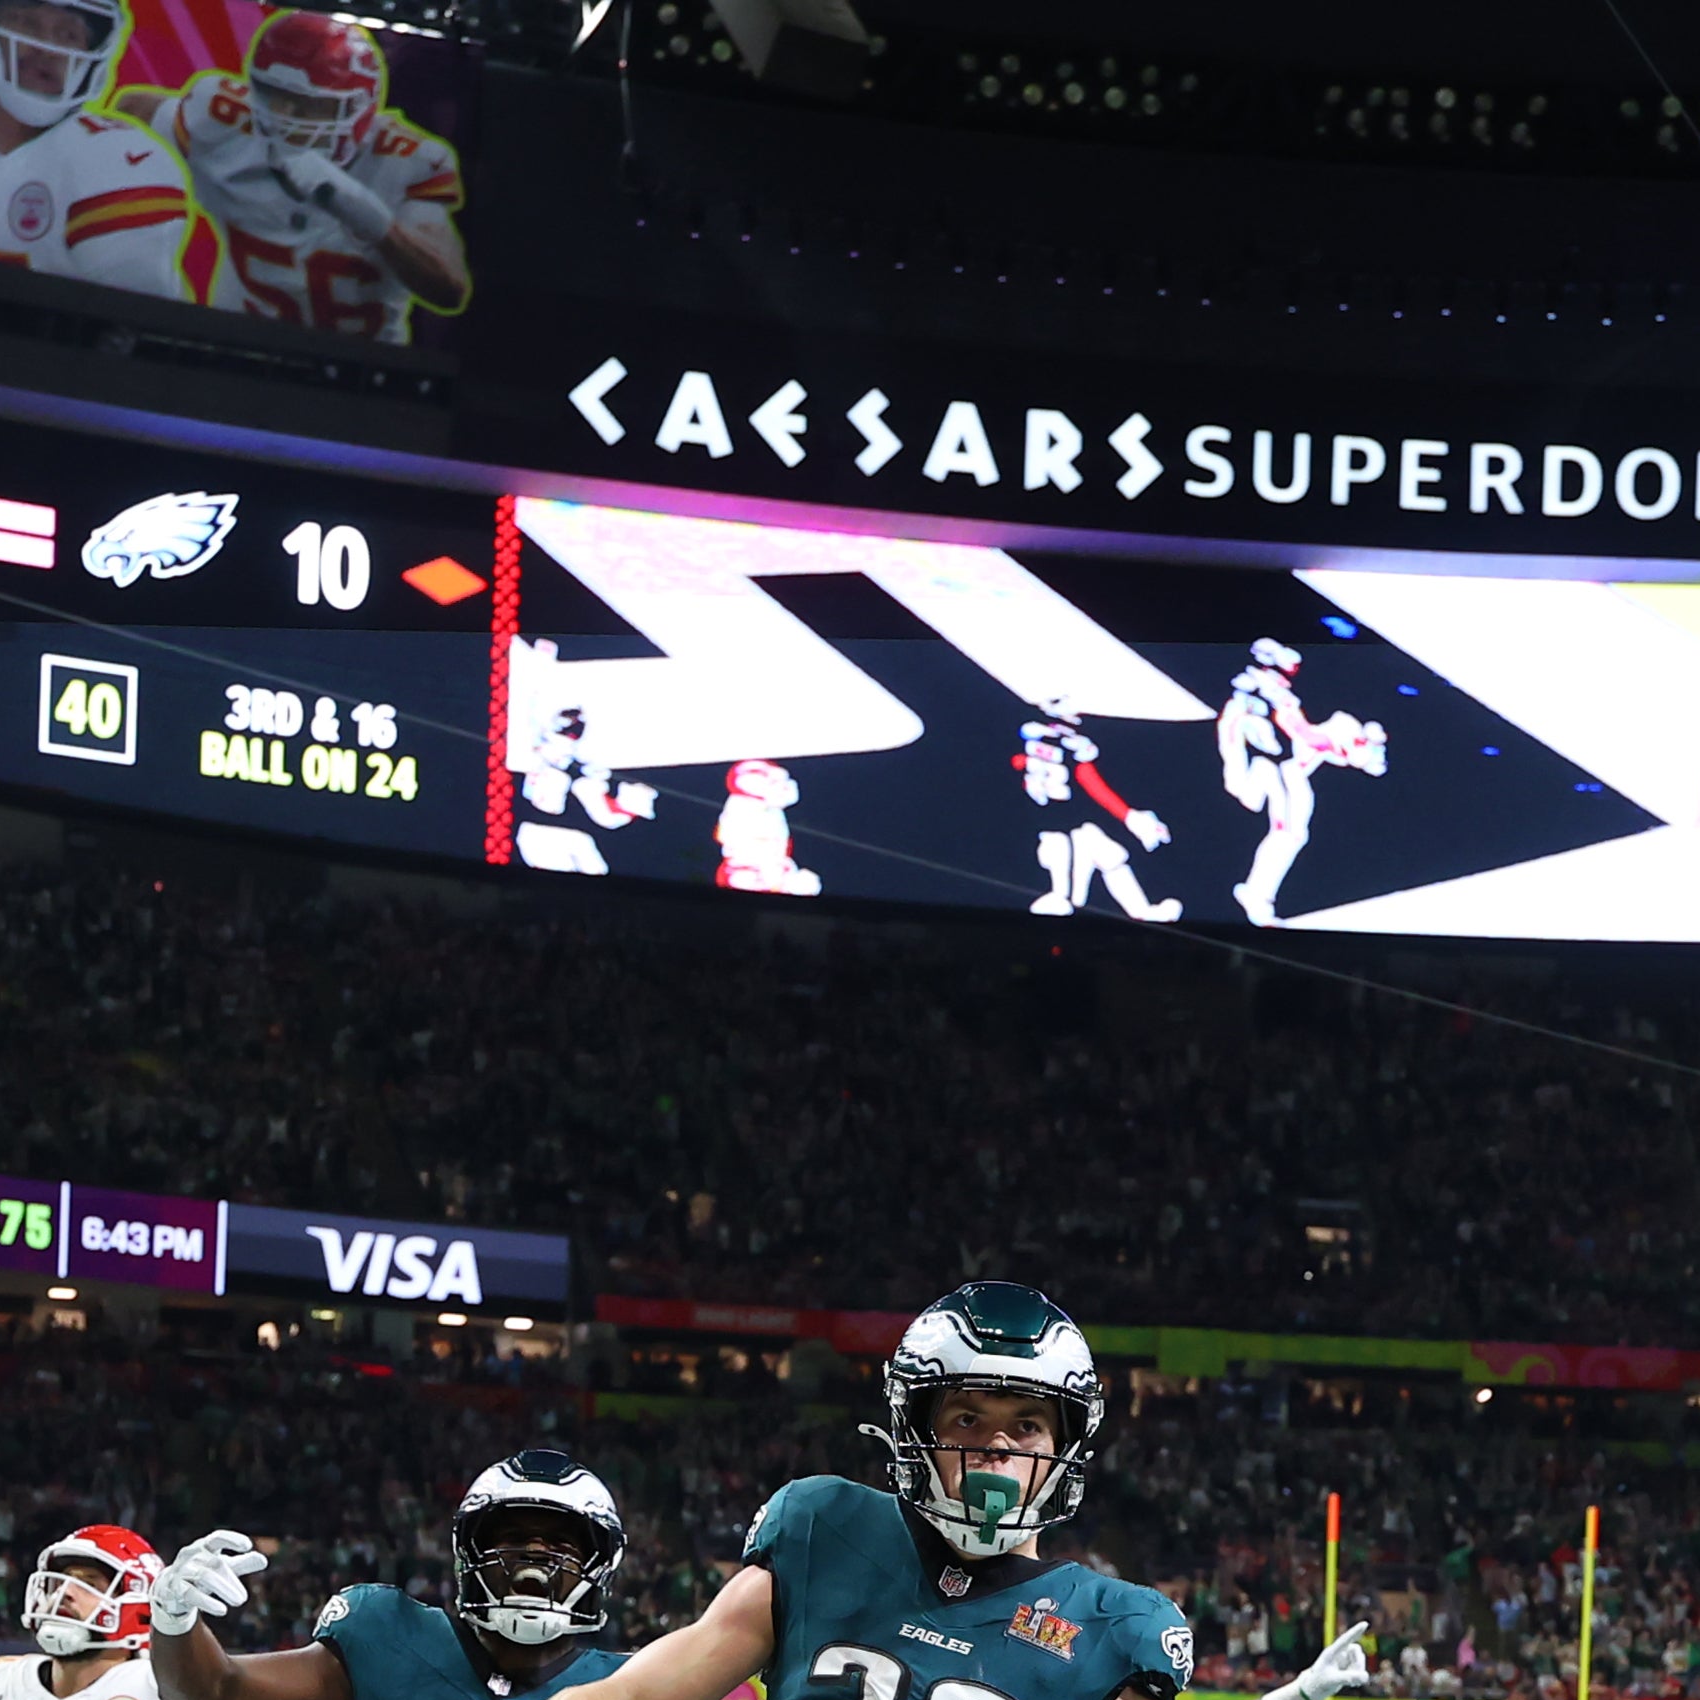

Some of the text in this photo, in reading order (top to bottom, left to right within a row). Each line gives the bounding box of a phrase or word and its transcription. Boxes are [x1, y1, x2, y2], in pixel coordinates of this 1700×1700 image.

[568, 357, 1164, 499] CAESARS
[282, 522, 369, 610] 10
[55, 680, 122, 738] 40
[224, 684, 398, 749] 3RD & 16
[201, 730, 418, 801] BALL ON 24
[82, 1217, 203, 1261] 6:43 PM
[305, 1225, 481, 1304] VISA
[899, 1623, 974, 1656] EAGLES
